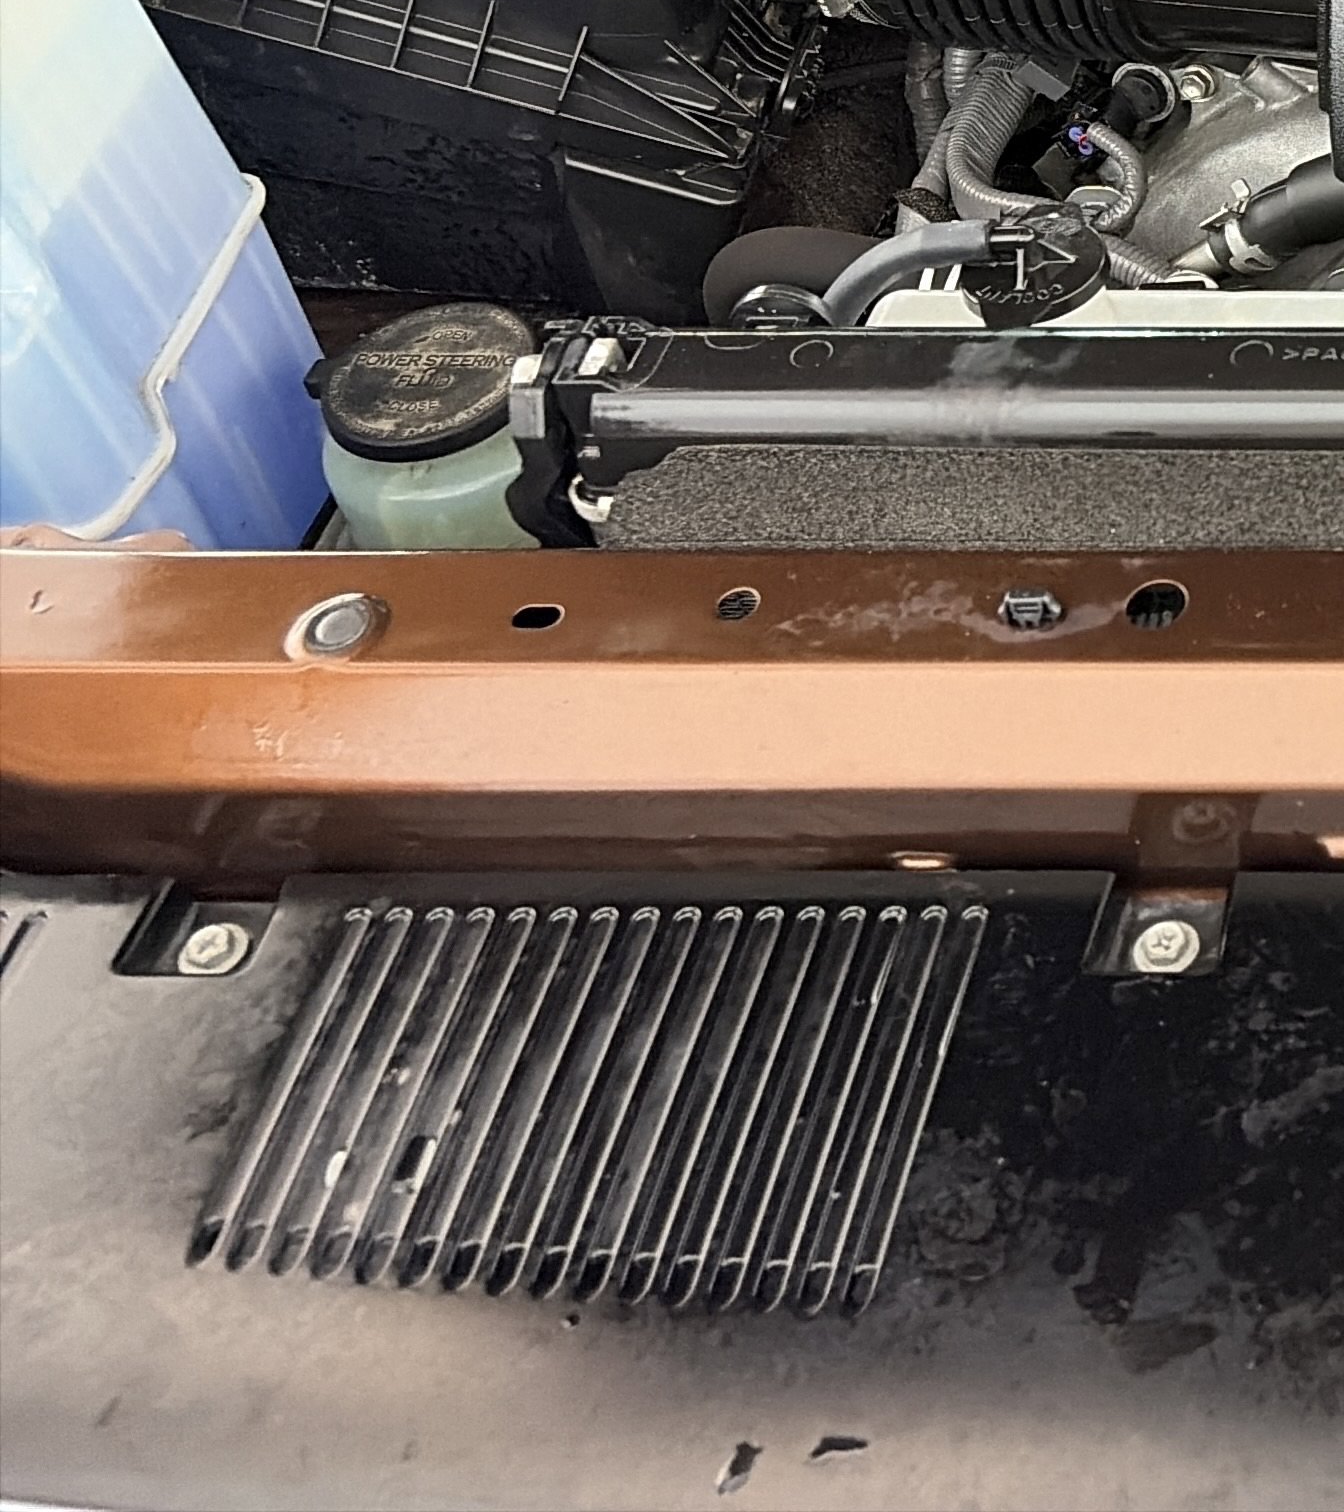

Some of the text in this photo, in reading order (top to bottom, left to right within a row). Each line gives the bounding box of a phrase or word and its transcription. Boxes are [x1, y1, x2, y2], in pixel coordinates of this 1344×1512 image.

[430, 330, 473, 342] OPEN
[353, 353, 517, 369] POWER STEERING
[393, 373, 453, 388] FLUID
[387, 399, 442, 414] CLOSE
